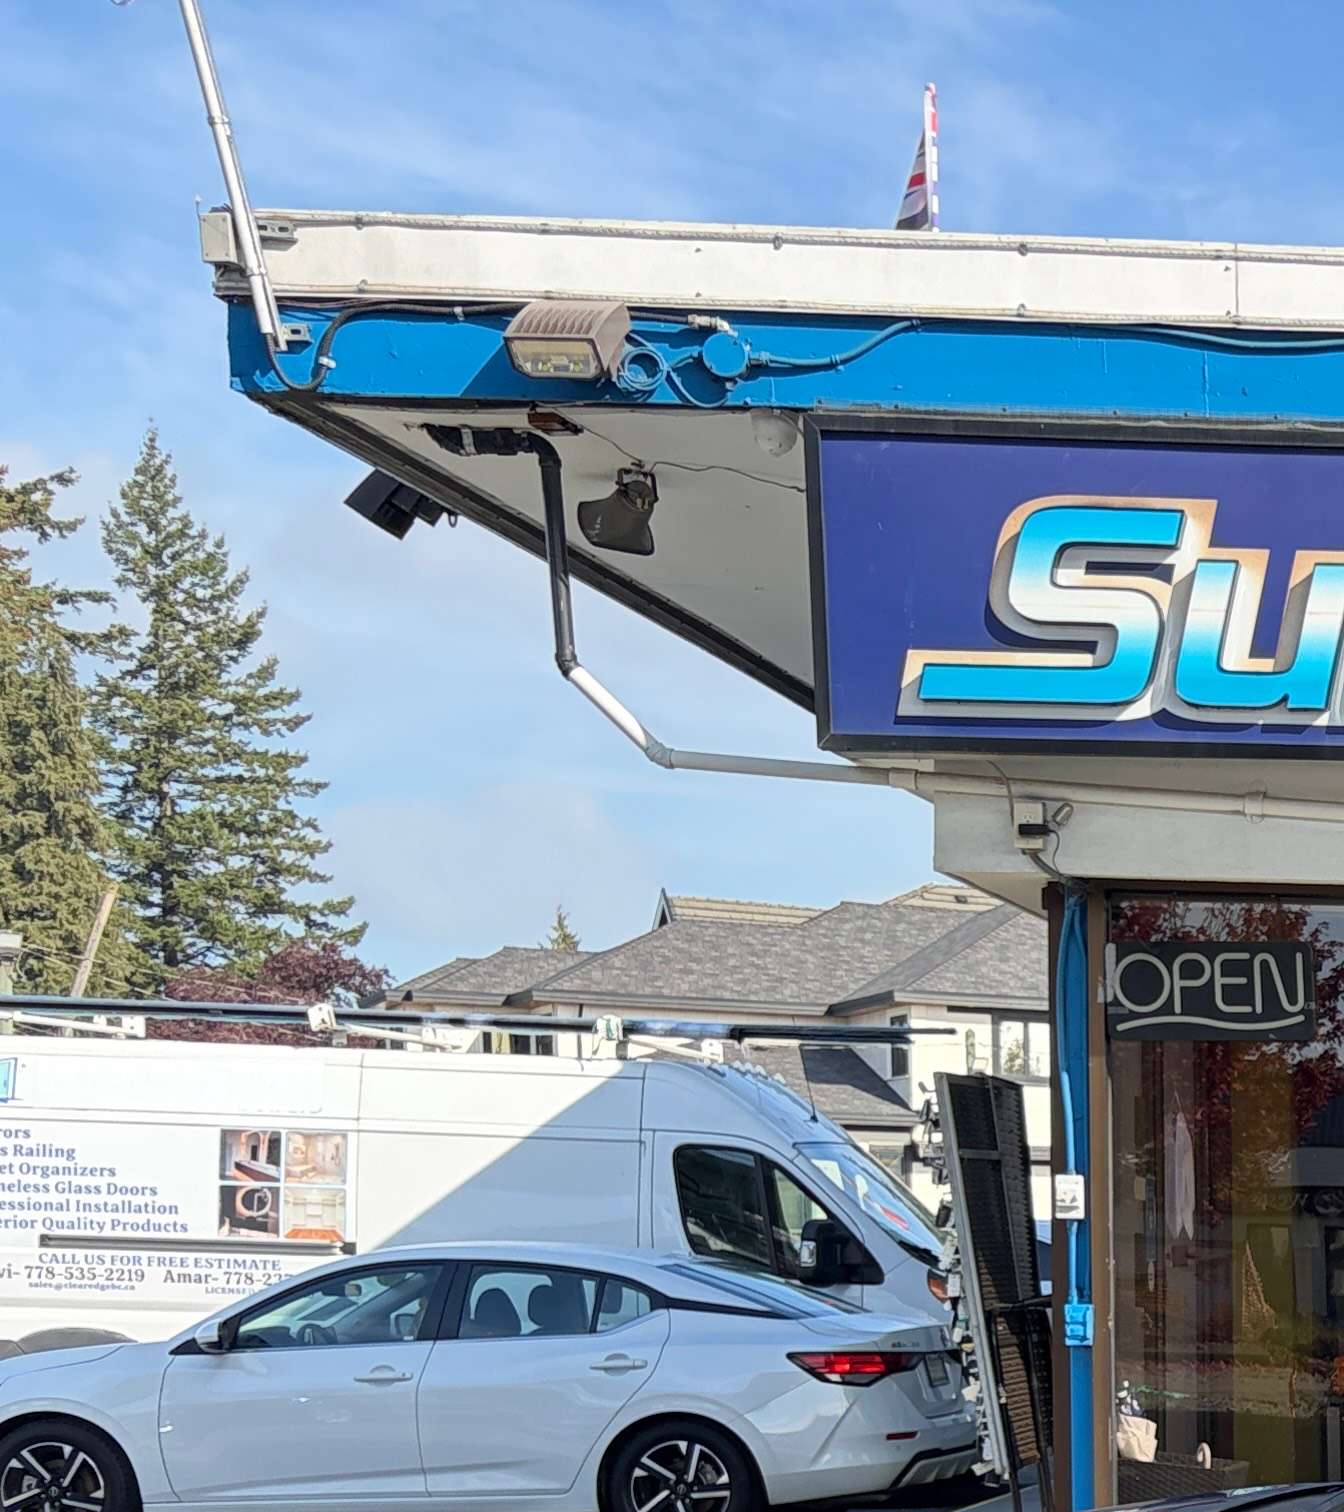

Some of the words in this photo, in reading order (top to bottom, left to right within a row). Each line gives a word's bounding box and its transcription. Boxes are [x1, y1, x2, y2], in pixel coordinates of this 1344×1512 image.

[1114, 952, 1305, 1014] OPEN
[0, 1128, 31, 1139] ors
[13, 1143, 76, 1161] Railing
[19, 1162, 117, 1179] Organizers
[54, 1180, 102, 1195] Glass
[106, 1182, 158, 1197] Doors
[76, 1199, 179, 1215] Installation
[0, 1214, 38, 1230] rior
[42, 1216, 106, 1234] Quality
[110, 1218, 188, 1233] Products
[38, 1253, 80, 1265] CALL
[84, 1254, 106, 1266] US
[110, 1255, 143, 1267] FOR
[147, 1256, 190, 1268] FREE
[194, 1257, 282, 1271] ESTIMATE
[24, 1265, 146, 1282] 778-535-2219
